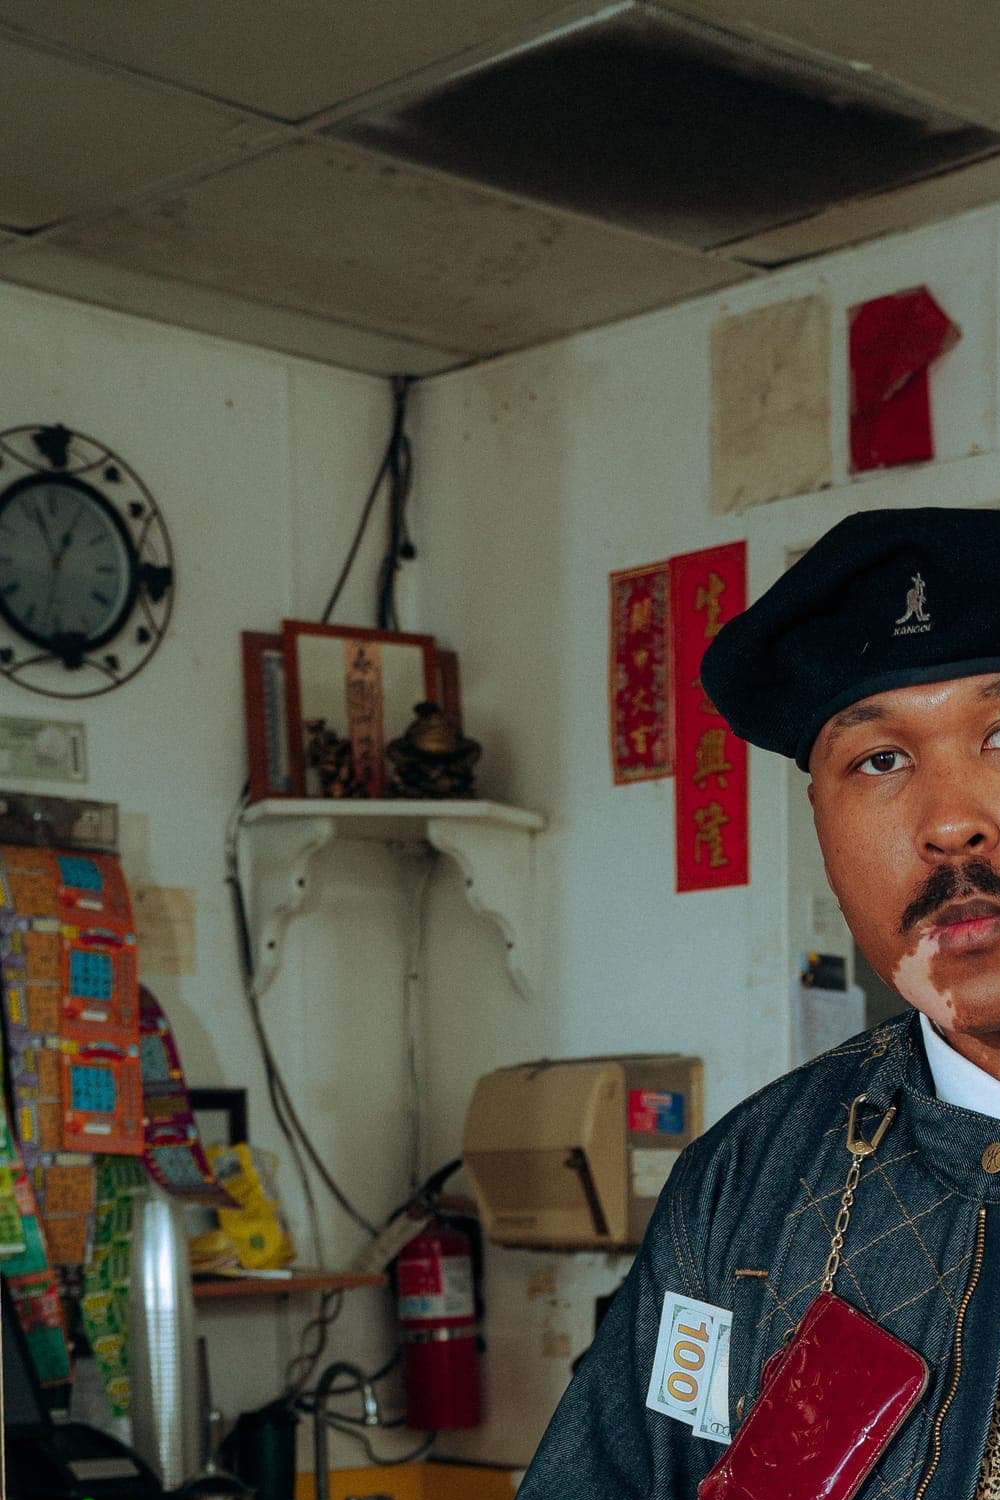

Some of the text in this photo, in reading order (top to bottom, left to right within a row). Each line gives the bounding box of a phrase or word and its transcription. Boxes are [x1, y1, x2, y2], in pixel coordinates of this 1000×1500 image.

[894, 624, 931, 636] KANGOL
[692, 571, 733, 868] 生興隆
[667, 1322, 709, 1402] 100
